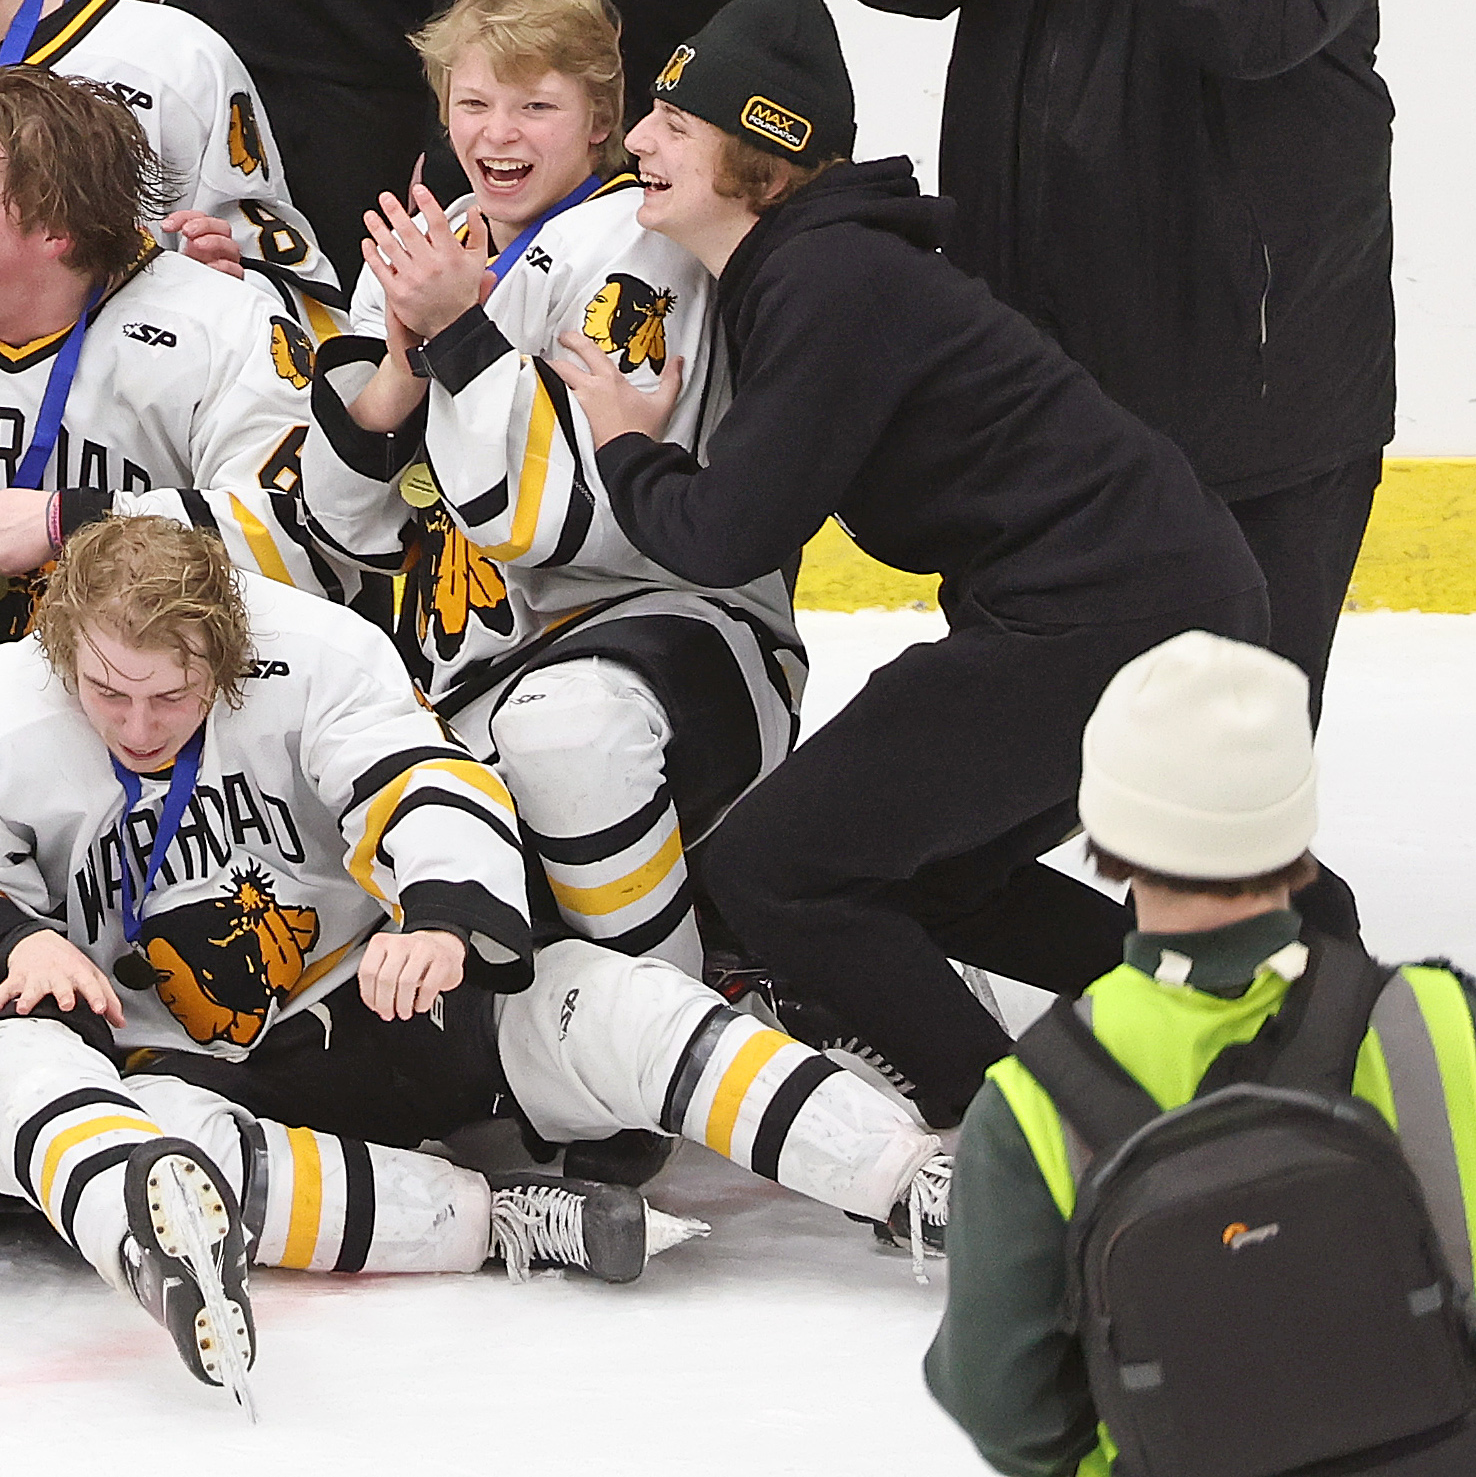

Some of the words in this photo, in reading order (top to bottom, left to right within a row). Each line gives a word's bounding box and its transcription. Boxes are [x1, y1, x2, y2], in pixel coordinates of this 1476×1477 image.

[748, 114, 801, 145] FOUNDATION
[752, 105, 795, 132] MAX
[129, 323, 177, 347] SP
